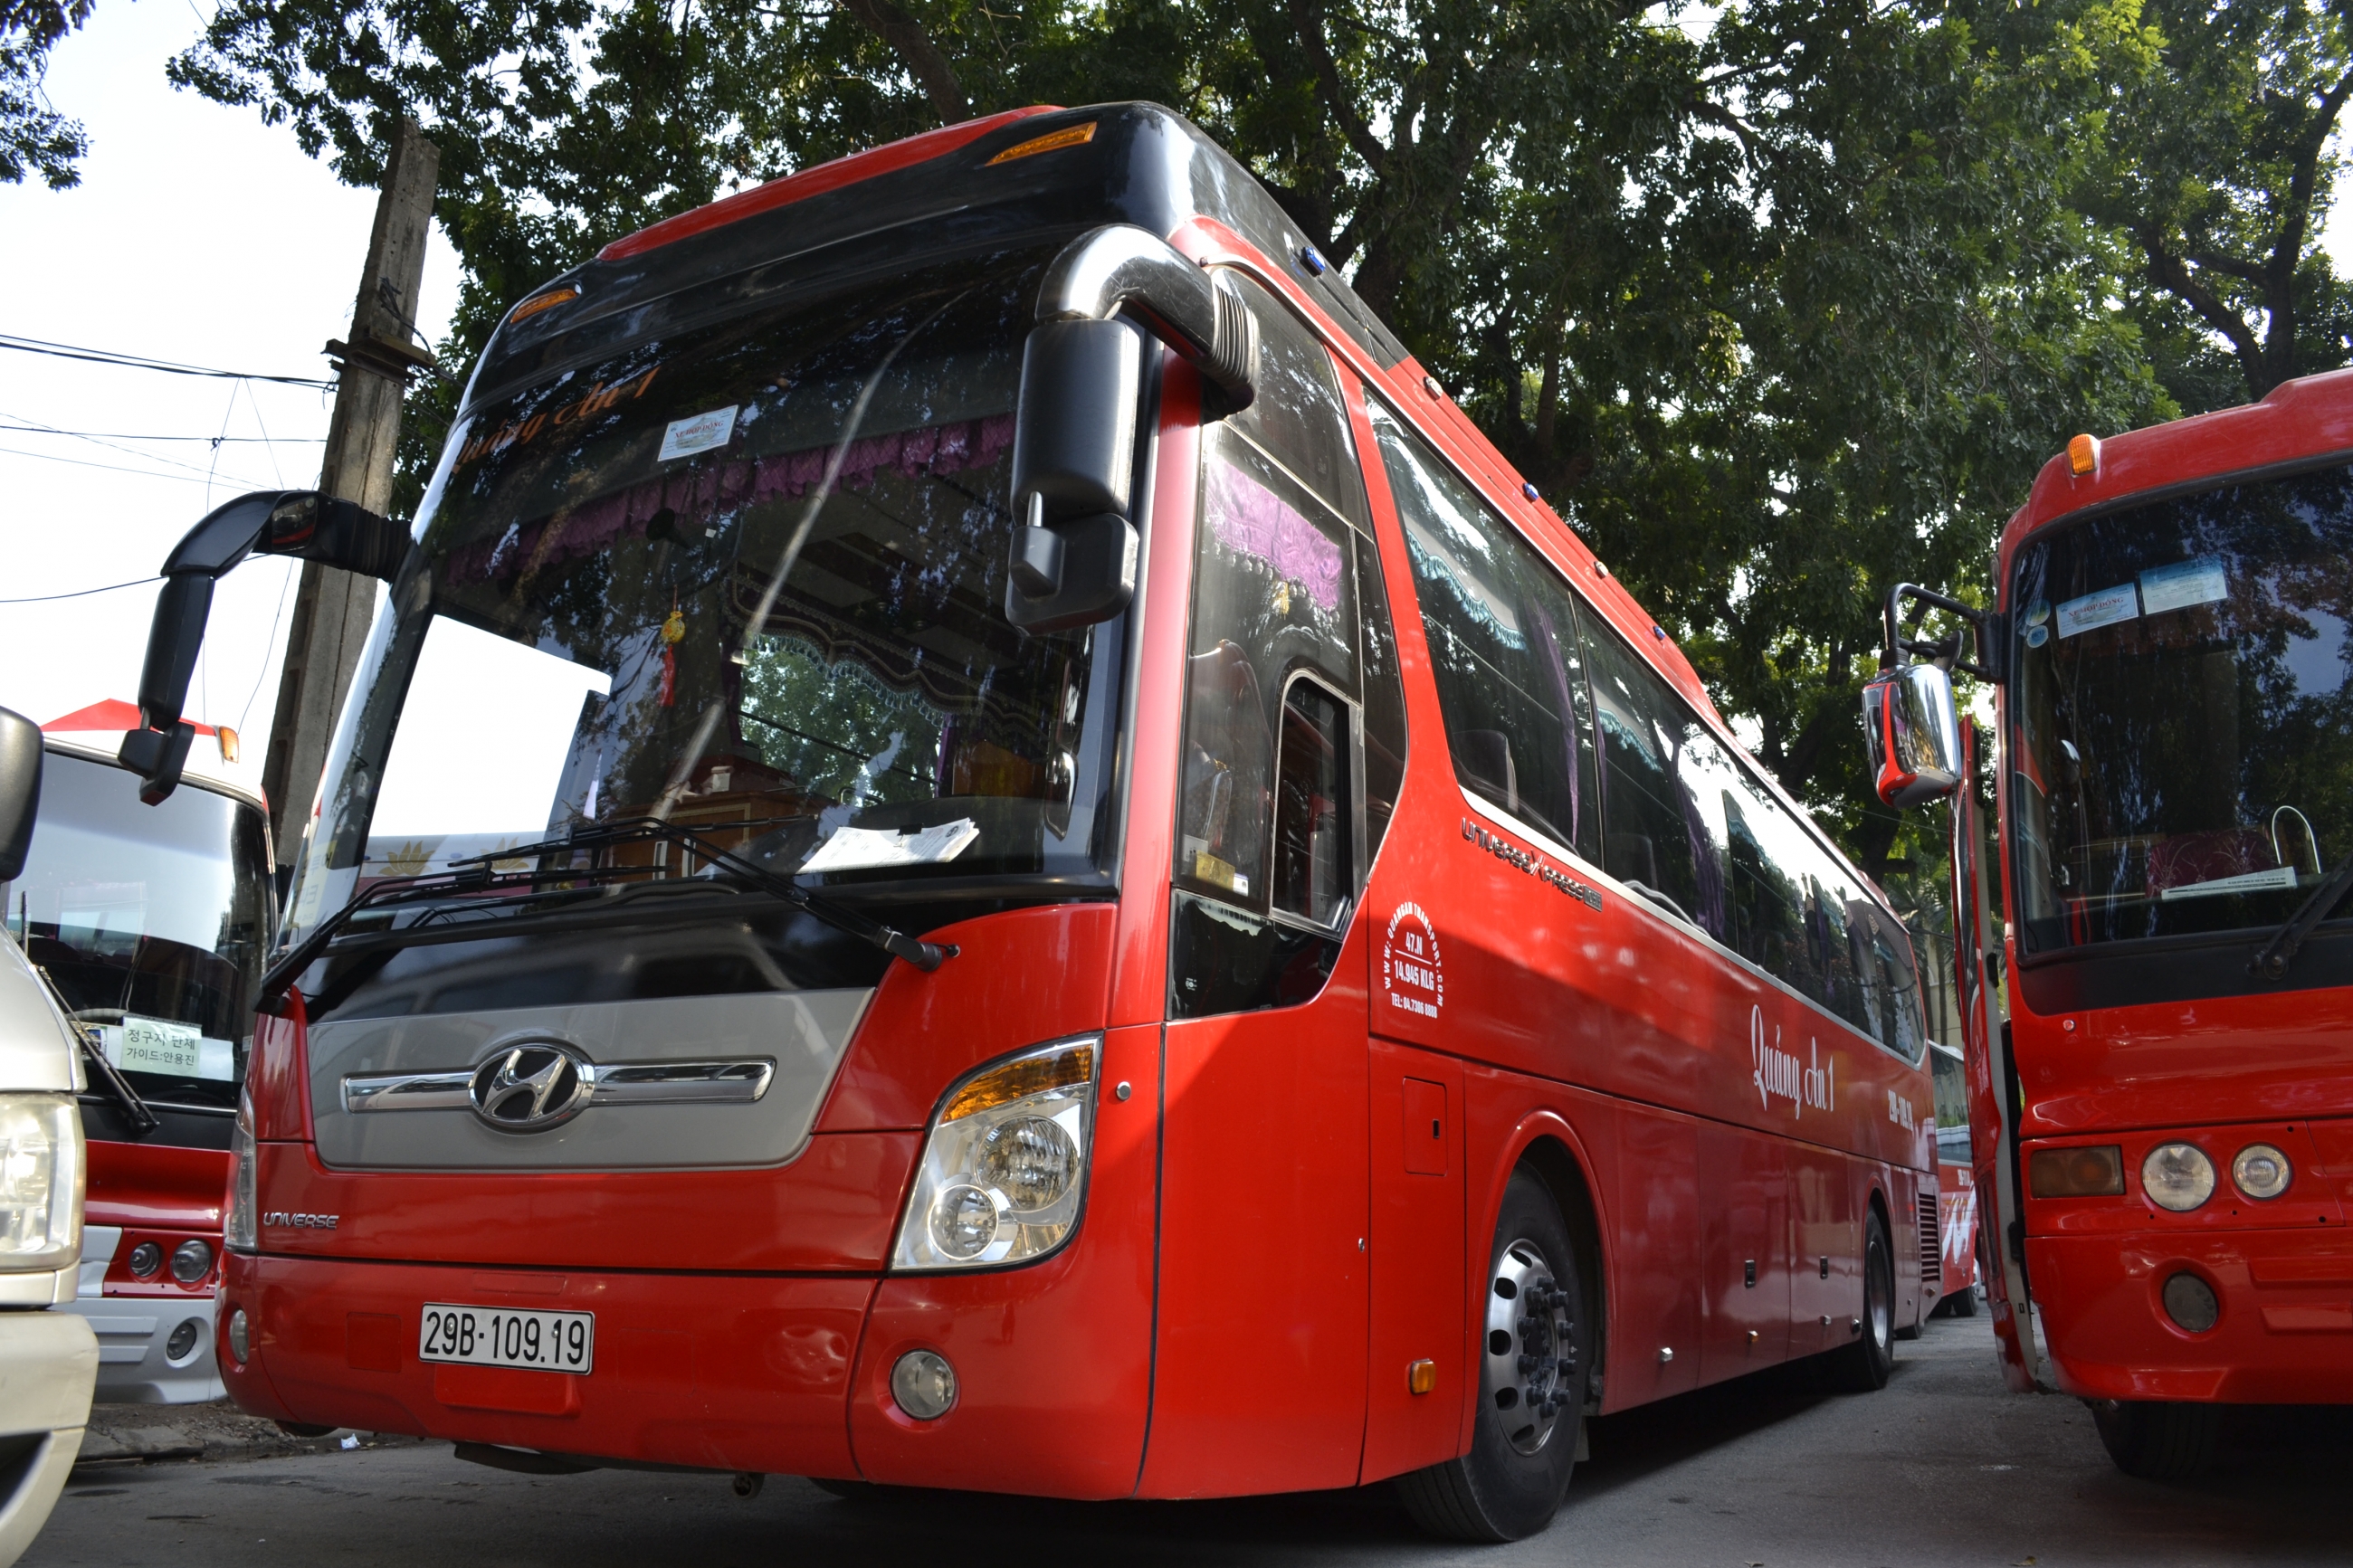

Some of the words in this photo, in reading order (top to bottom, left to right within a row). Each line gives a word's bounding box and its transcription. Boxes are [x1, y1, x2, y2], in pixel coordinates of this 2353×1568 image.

[634, 366, 661, 398] 1
[1395, 959, 1419, 985] 14.945
[1421, 968, 1434, 991] KLG
[1391, 993, 1403, 1009] TEL:
[1751, 1004, 1802, 1120] Quảng
[1828, 1056, 1834, 1112] 1
[263, 1212, 339, 1229] UNIVERSE
[424, 1311, 586, 1364] 29B-109.19
